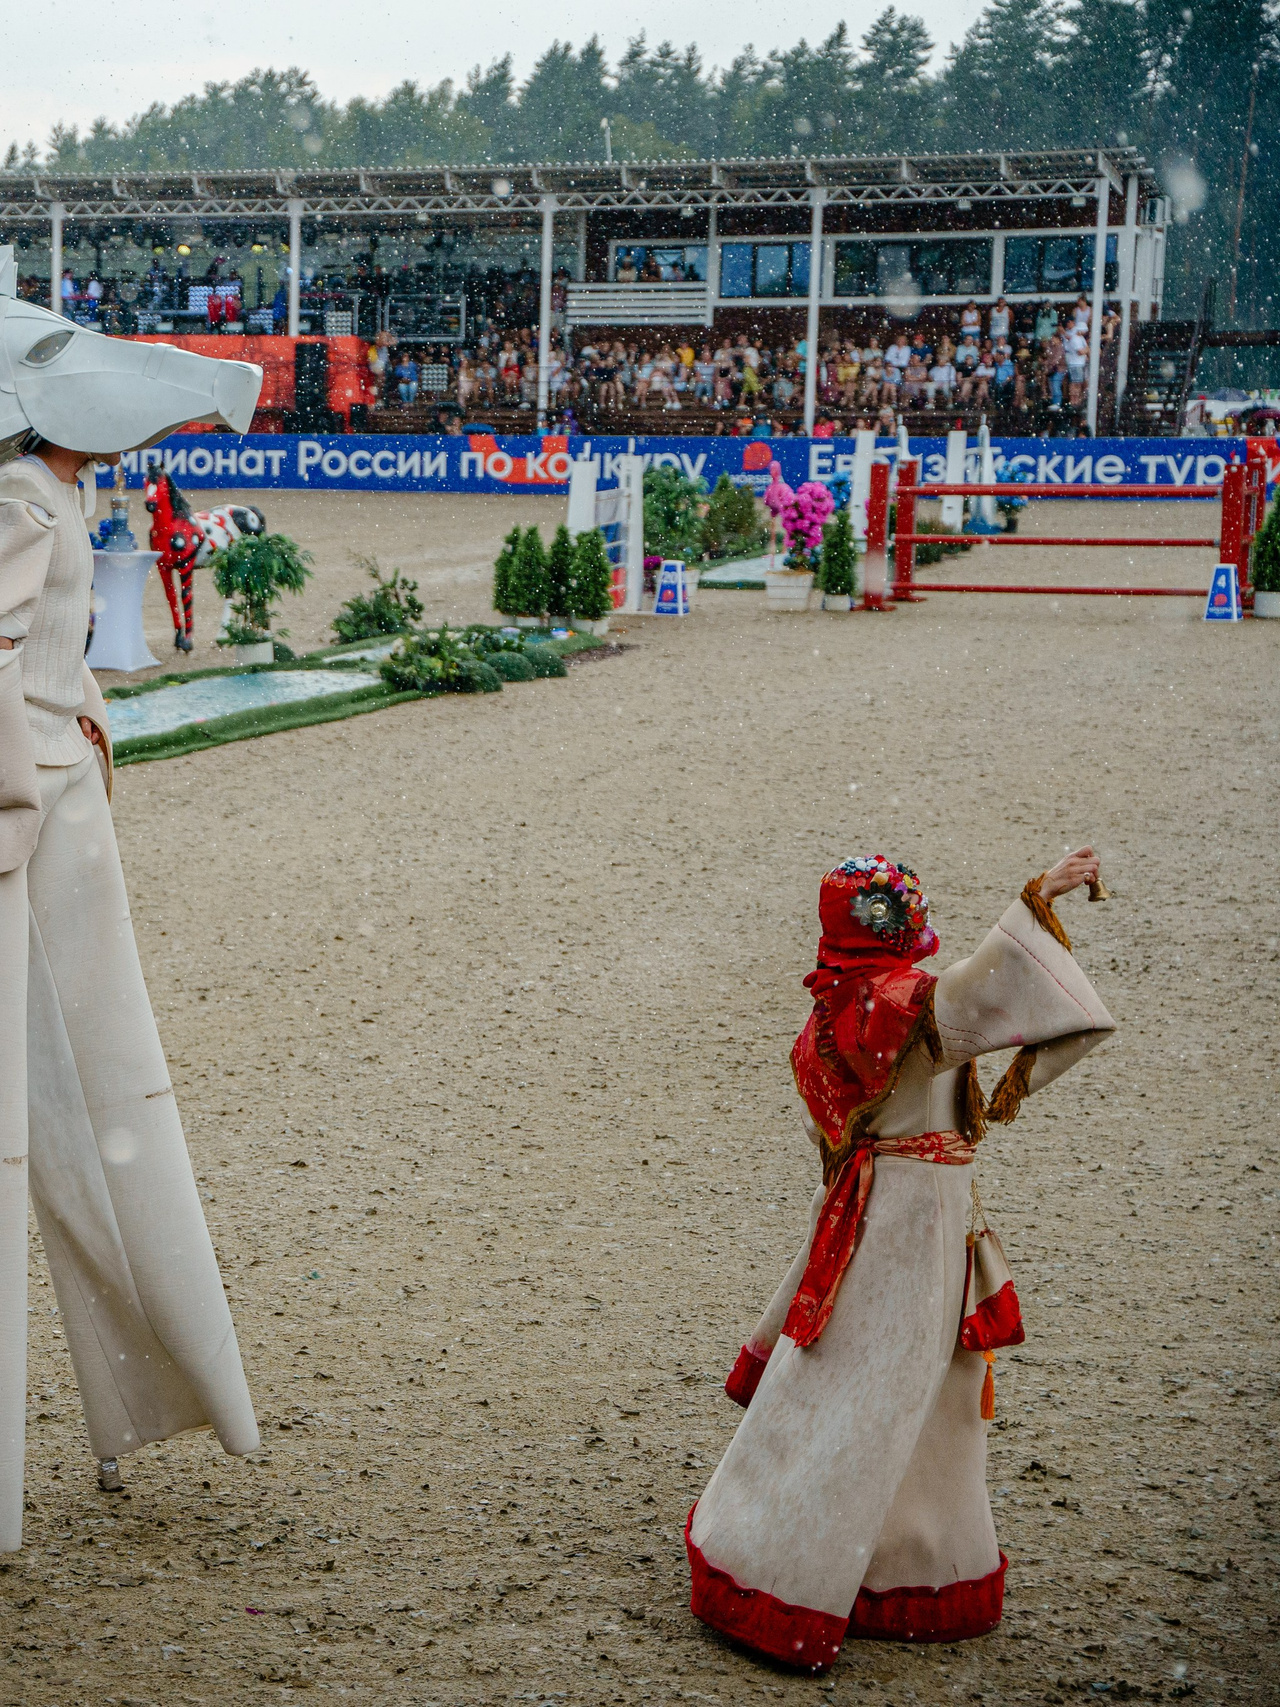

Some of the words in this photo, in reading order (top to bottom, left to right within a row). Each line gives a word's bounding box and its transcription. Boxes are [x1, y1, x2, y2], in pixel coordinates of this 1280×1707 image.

[94, 448, 288, 476] мпионат
[297, 440, 448, 478] России
[460, 451, 514, 479] по
